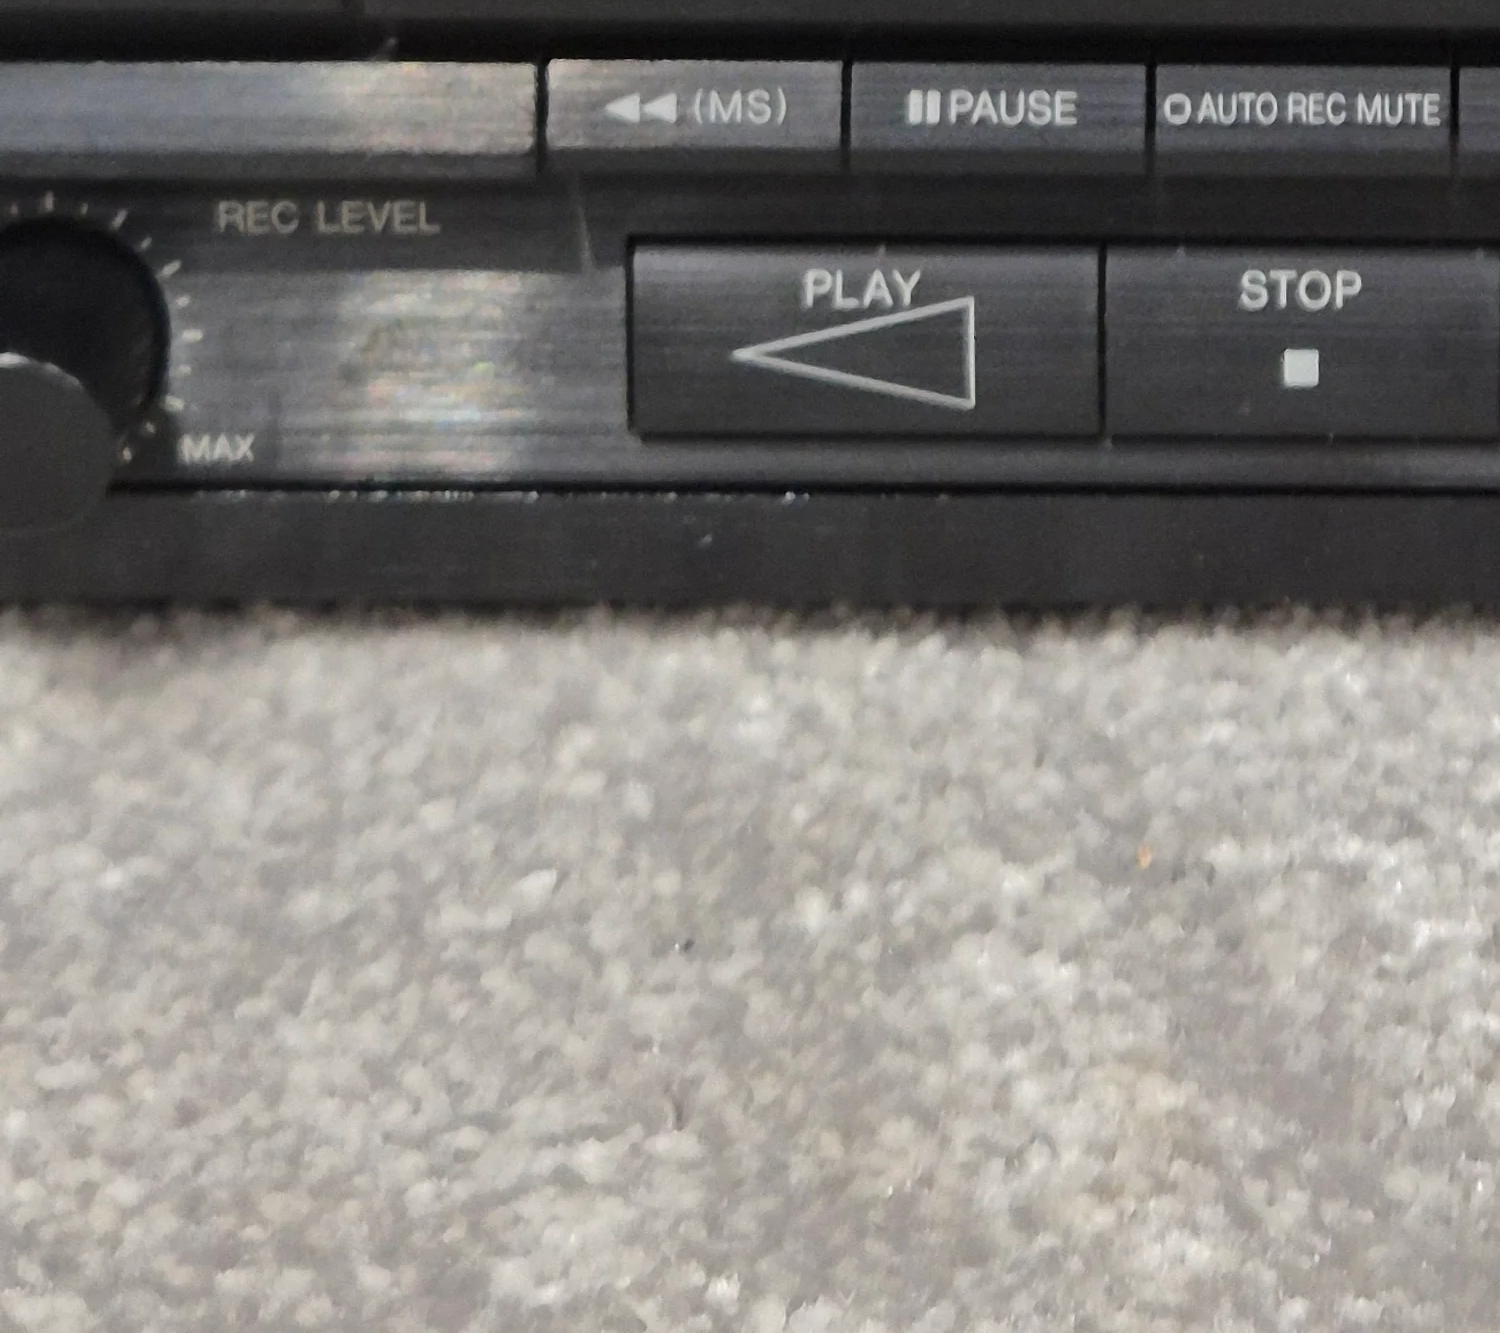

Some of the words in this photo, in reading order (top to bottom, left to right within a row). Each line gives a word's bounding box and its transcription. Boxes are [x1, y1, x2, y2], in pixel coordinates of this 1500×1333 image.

[693, 87, 788, 126] (MS)
[948, 89, 1079, 126] PAUSE
[1197, 94, 1278, 126] AUTO
[1286, 95, 1347, 126] REC
[1357, 95, 1441, 127] MUTE
[214, 199, 299, 233] REC
[316, 200, 440, 234] LEVEL
[804, 269, 923, 312] PLAY
[1239, 270, 1362, 312] STOP
[178, 433, 256, 464] MAX
